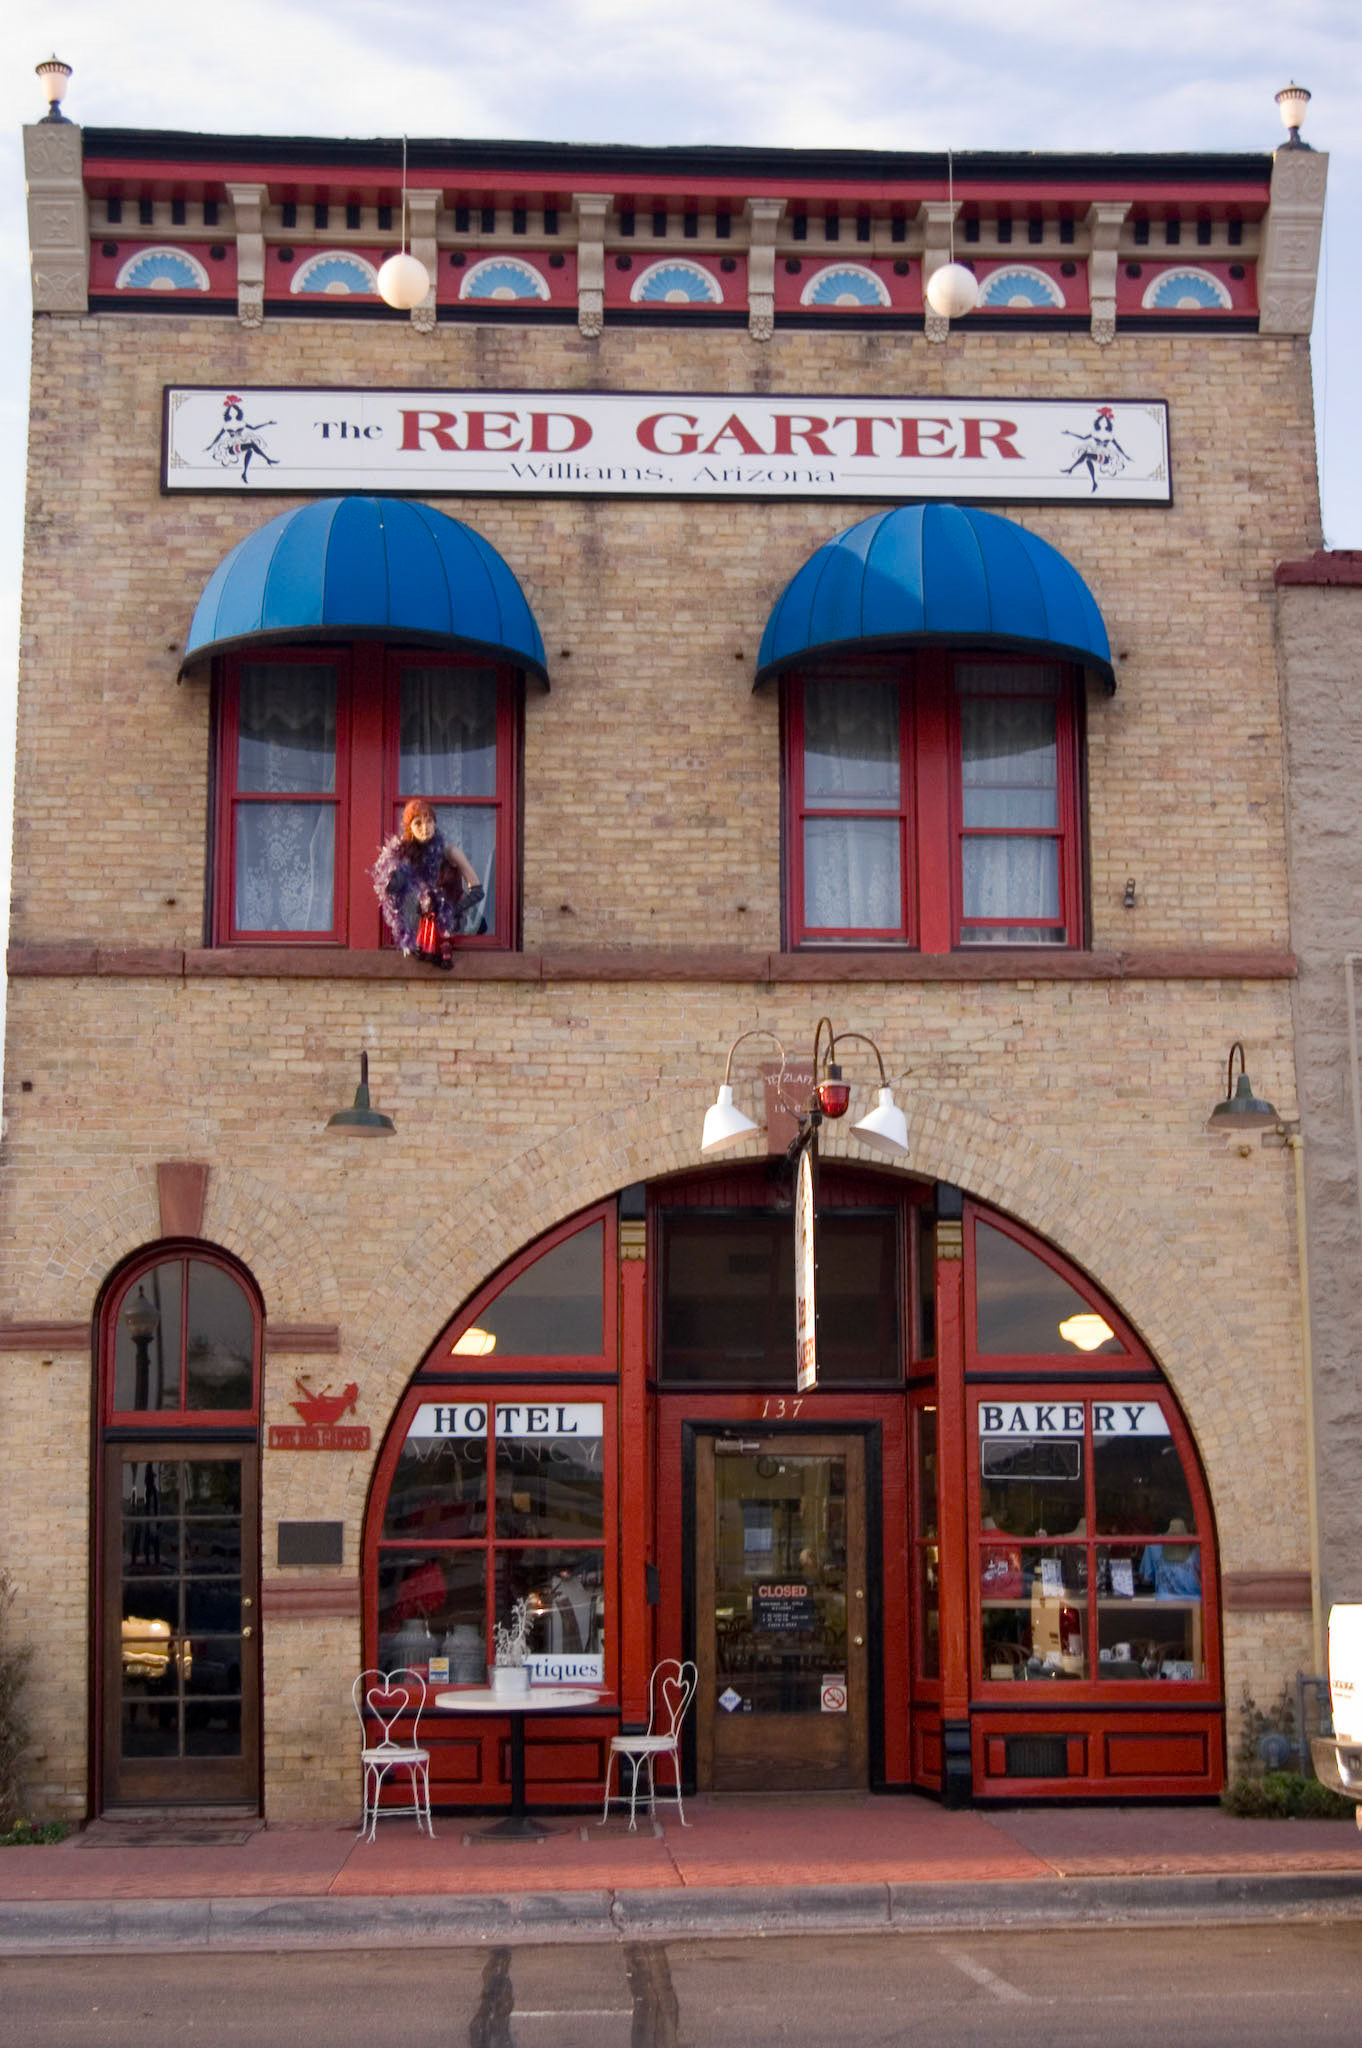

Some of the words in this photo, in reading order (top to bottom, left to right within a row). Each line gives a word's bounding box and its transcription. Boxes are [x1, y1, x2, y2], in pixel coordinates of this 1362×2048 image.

[313, 420, 384, 440] The
[396, 409, 593, 453] RED
[635, 412, 1026, 460] GARTER
[510, 462, 674, 482] Williams,
[692, 466, 836, 483] Arizona
[433, 1407, 578, 1433] HOTEL
[762, 1399, 804, 1419] 137
[981, 1405, 1146, 1431] BAKERY
[411, 1439, 601, 1463] VACANCY
[759, 1585, 808, 1598] CLOSED
[534, 1658, 599, 1681] tiques
